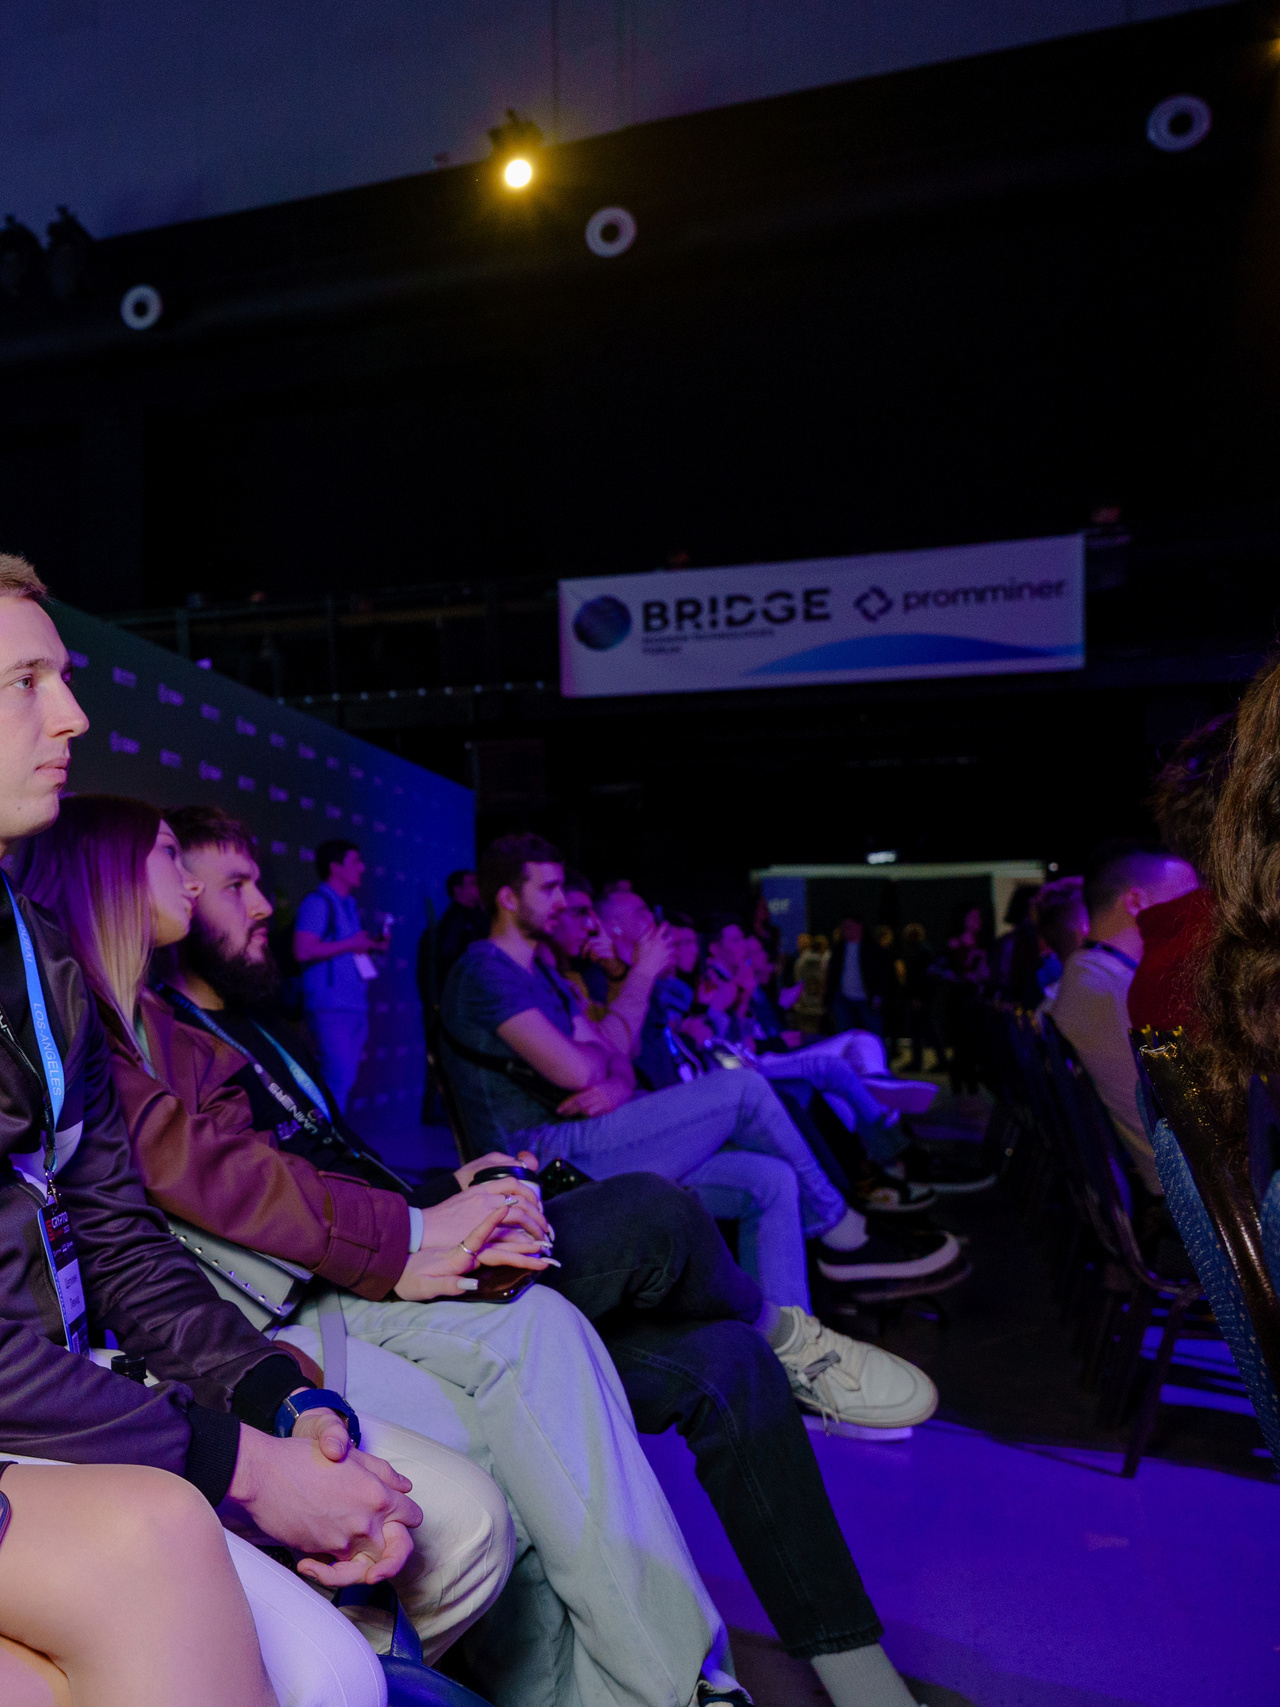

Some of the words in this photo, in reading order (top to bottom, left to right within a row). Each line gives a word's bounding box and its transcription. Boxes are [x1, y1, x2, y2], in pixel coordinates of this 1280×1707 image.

[902, 578, 1067, 615] promminer
[33, 1002, 63, 1097] LOS-ANGELES
[51, 1211, 69, 1229] CRYPTO
